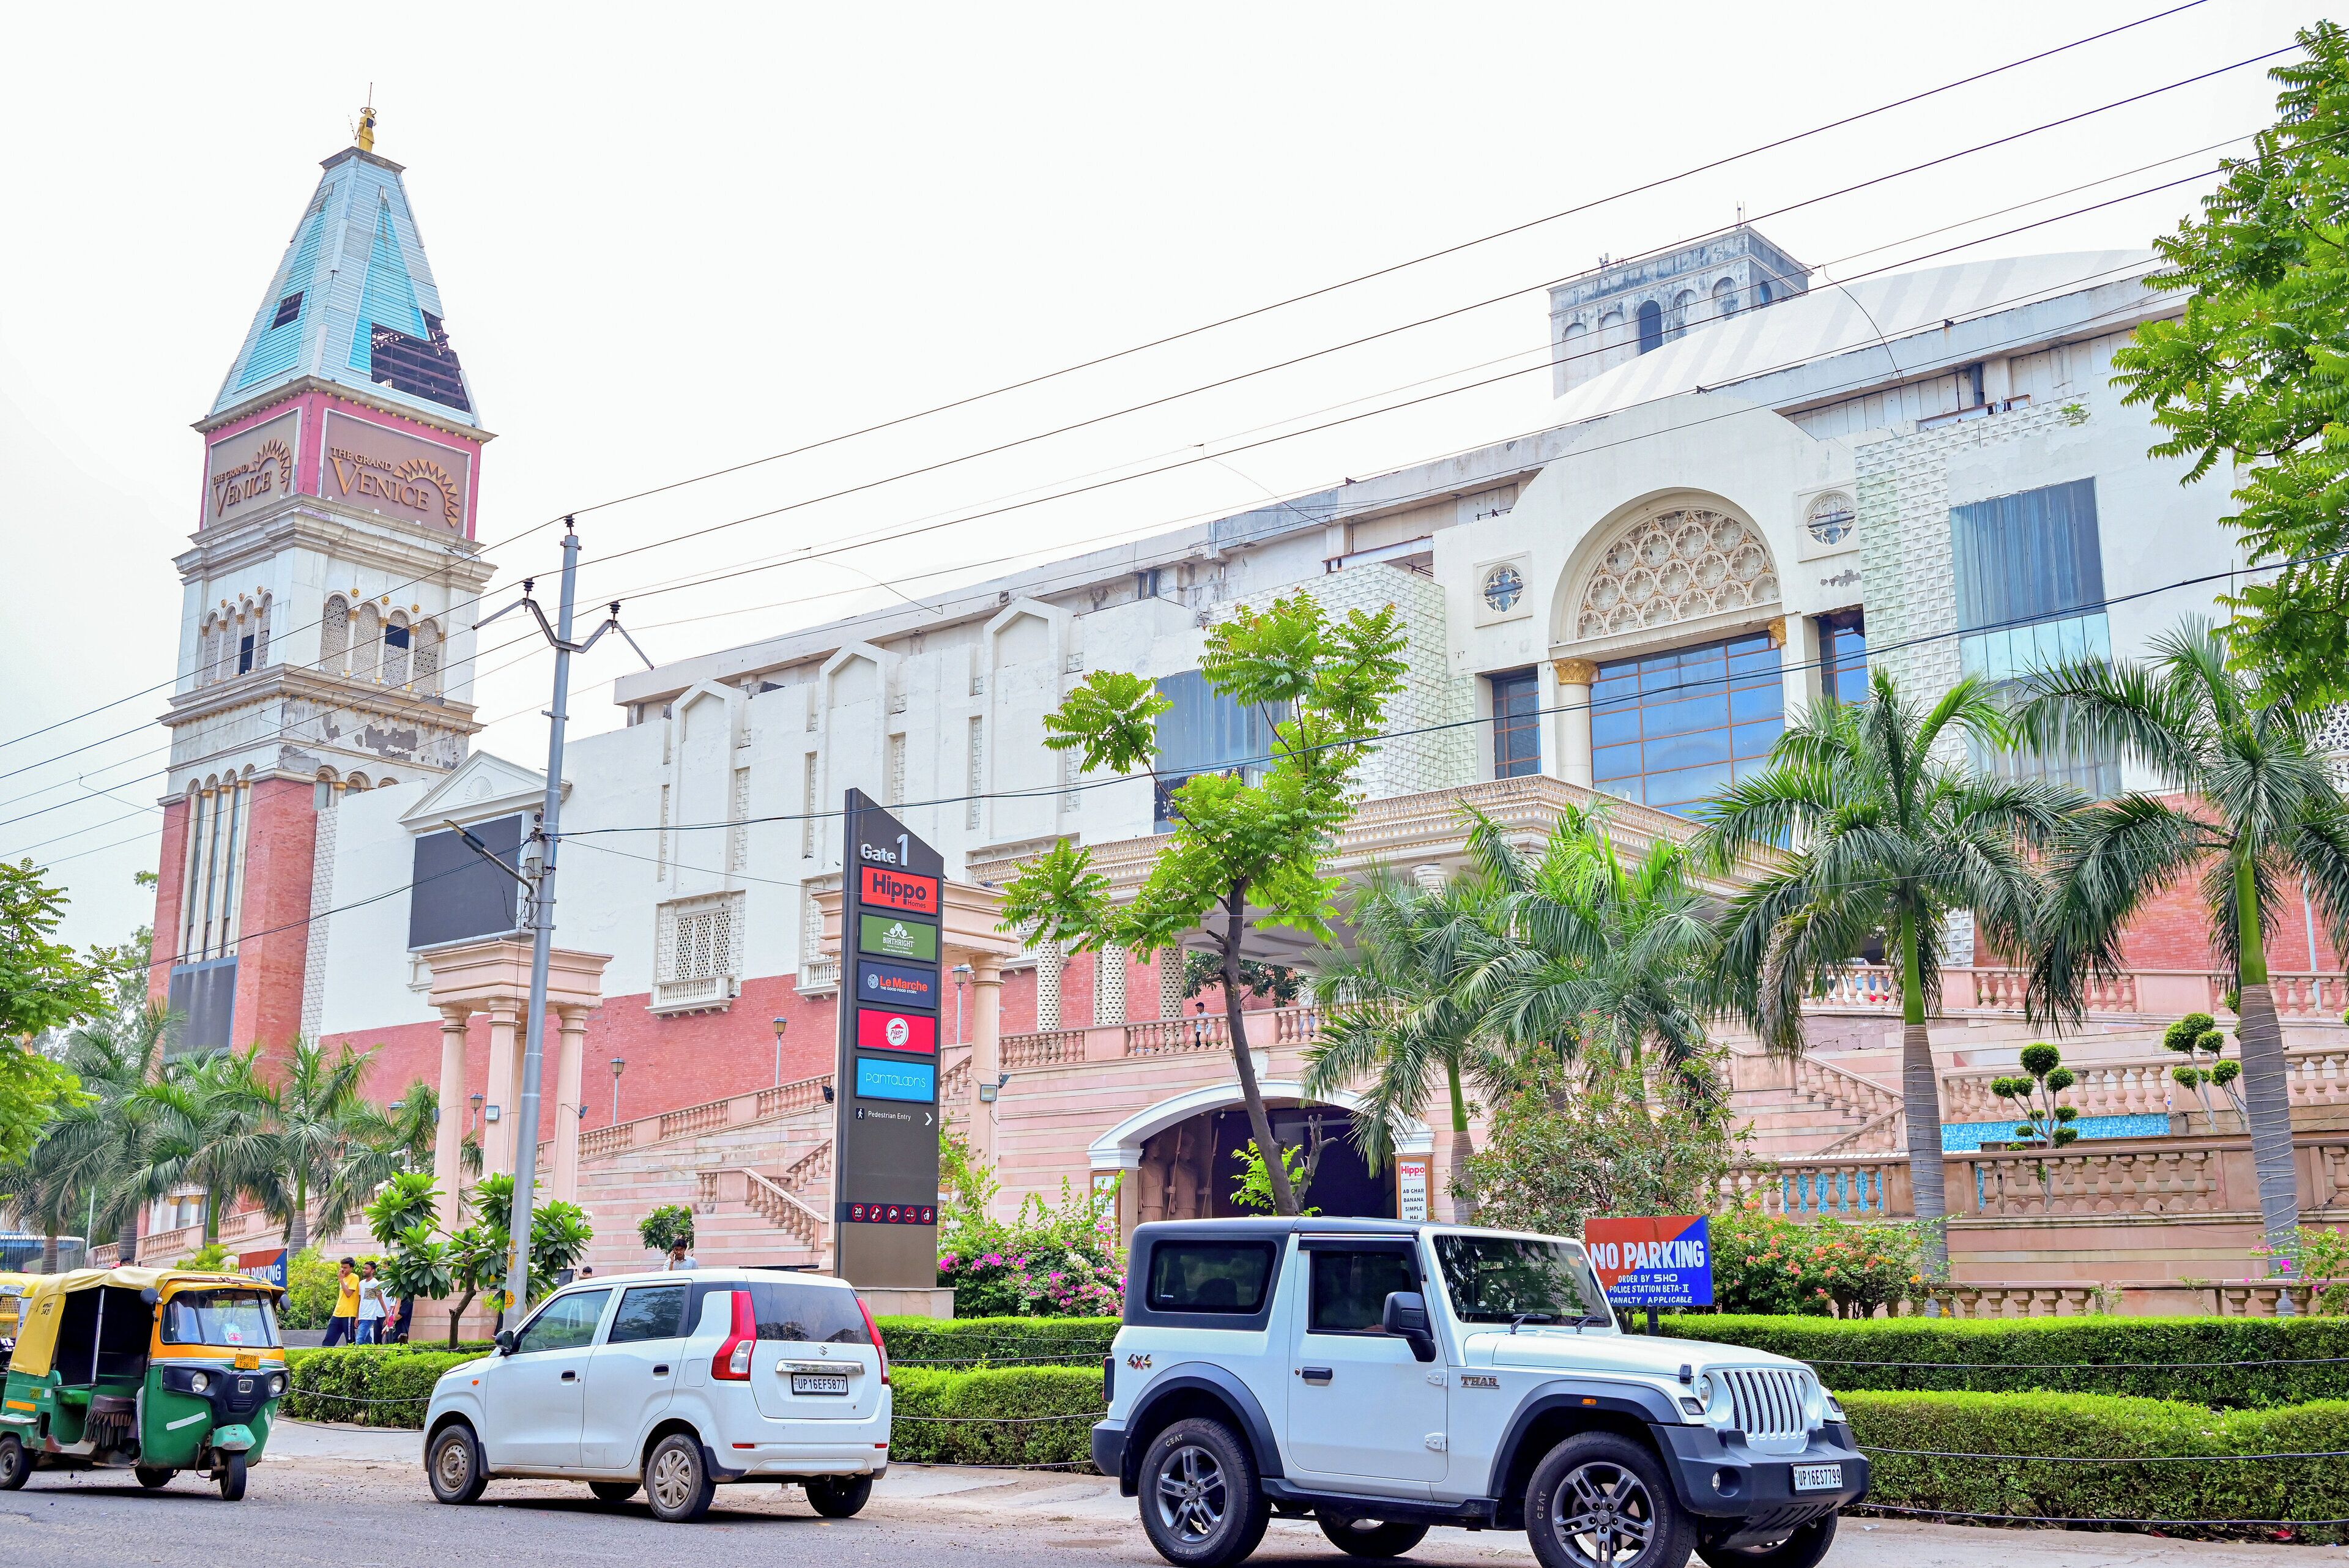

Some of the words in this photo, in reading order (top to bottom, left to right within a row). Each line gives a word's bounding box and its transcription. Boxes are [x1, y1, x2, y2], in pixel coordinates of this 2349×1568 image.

[331, 447, 352, 460] THE
[355, 453, 393, 471] GRAND
[212, 474, 225, 485] THE
[226, 465, 249, 480] GRAND
[328, 456, 429, 510] VENICE
[212, 470, 272, 518] VENICE
[860, 843, 896, 864] Gate
[896, 833, 908, 866] 1
[872, 872, 927, 905] Hippo
[908, 899, 926, 908] Homes
[882, 937, 915, 948] BIRTHRIGHT
[880, 975, 892, 987] Le
[892, 977, 928, 992] Marche
[868, 1110, 896, 1119] Pedestrian
[897, 1113, 911, 1121] Entry
[1401, 1165, 1425, 1177] Hippo
[1590, 1243, 1619, 1270] NO
[1623, 1241, 1705, 1269] PARKING
[251, 1264, 281, 1282] PARKING
[1641, 1274, 1650, 1283] BY
[1653, 1273, 1678, 1282] SHO
[1609, 1285, 1631, 1294] POLICE
[1632, 1285, 1661, 1293] STATION
[798, 1378, 845, 1391] UP16EF5877
[1461, 1376, 1499, 1387] THAR
[1165, 1434, 1183, 1447] CEAT
[1798, 1468, 1841, 1487] UP16ES7799
[1537, 1491, 1548, 1520] CEAT
